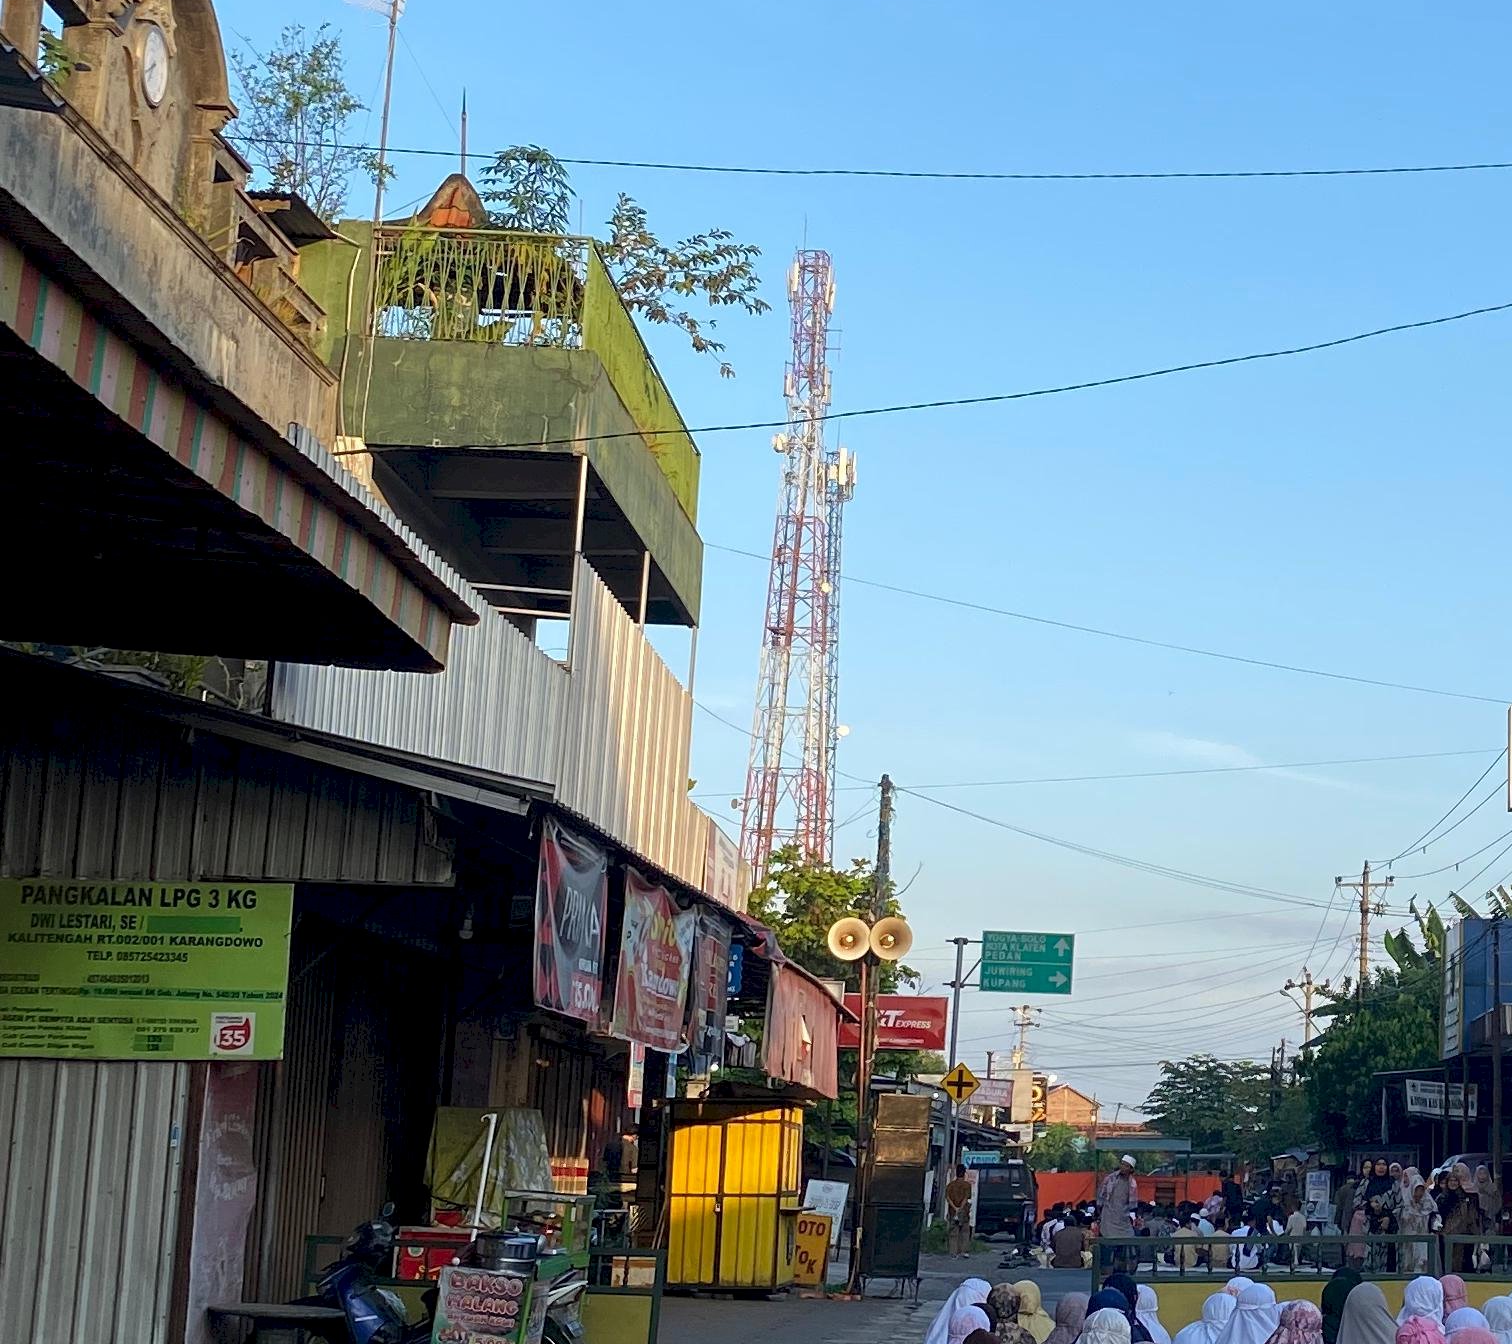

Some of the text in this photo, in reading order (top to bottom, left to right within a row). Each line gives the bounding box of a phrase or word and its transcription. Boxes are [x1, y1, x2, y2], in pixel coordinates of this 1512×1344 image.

[21, 885, 257, 909] PANGKALAN LPG 3 KG
[30, 913, 55, 928] DWI
[59, 914, 116, 932] LESTARI,
[120, 915, 137, 930] SE
[8, 933, 264, 948] KALITENGAH RT.002/001 KARANGDOWO
[1010, 943, 1046, 952] KLATEN
[87, 951, 188, 962] TELP. 085725423345
[985, 951, 1021, 960] PEDAN
[984, 967, 1032, 976] JUWIRING
[983, 978, 1026, 988] KUPANG
[895, 1020, 931, 1028] EXPRESS
[451, 1271, 523, 1296] BAKSO
[446, 1294, 519, 1315] MALANG
